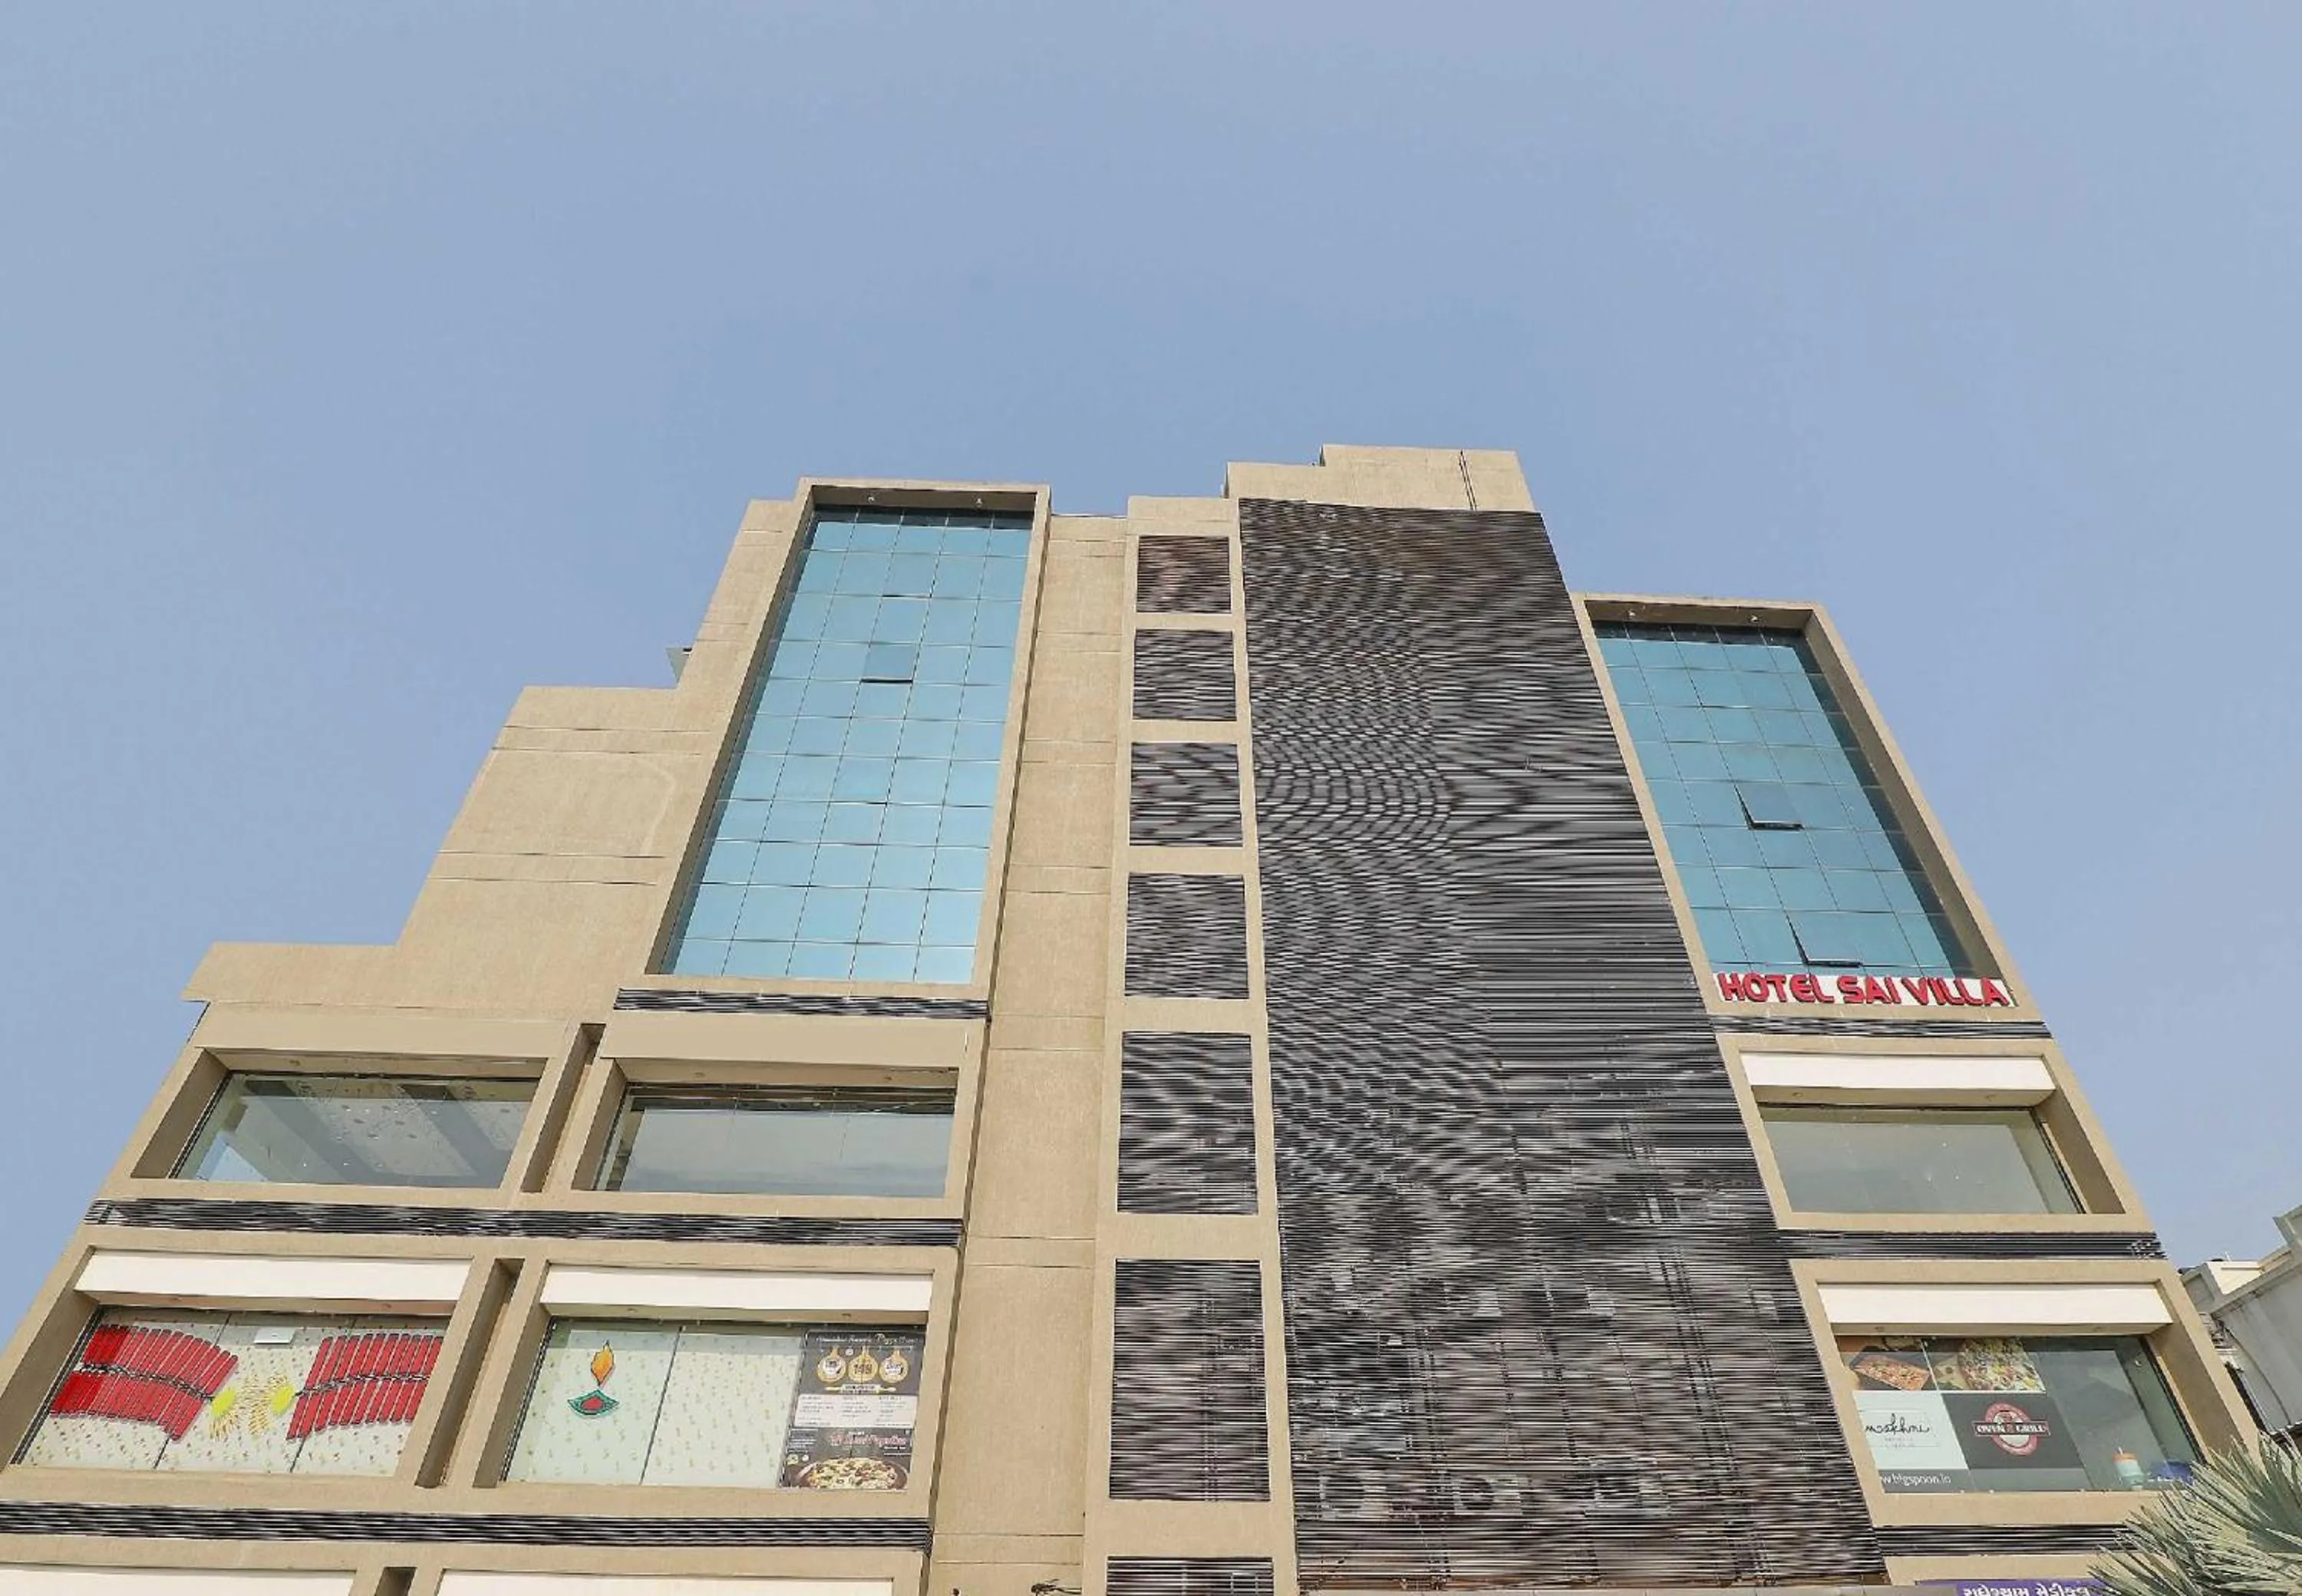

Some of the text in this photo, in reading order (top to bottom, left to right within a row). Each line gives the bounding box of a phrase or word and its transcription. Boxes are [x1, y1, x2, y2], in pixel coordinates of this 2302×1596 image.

[1718, 972, 2010, 1007] HOTEL SAI VILLA
